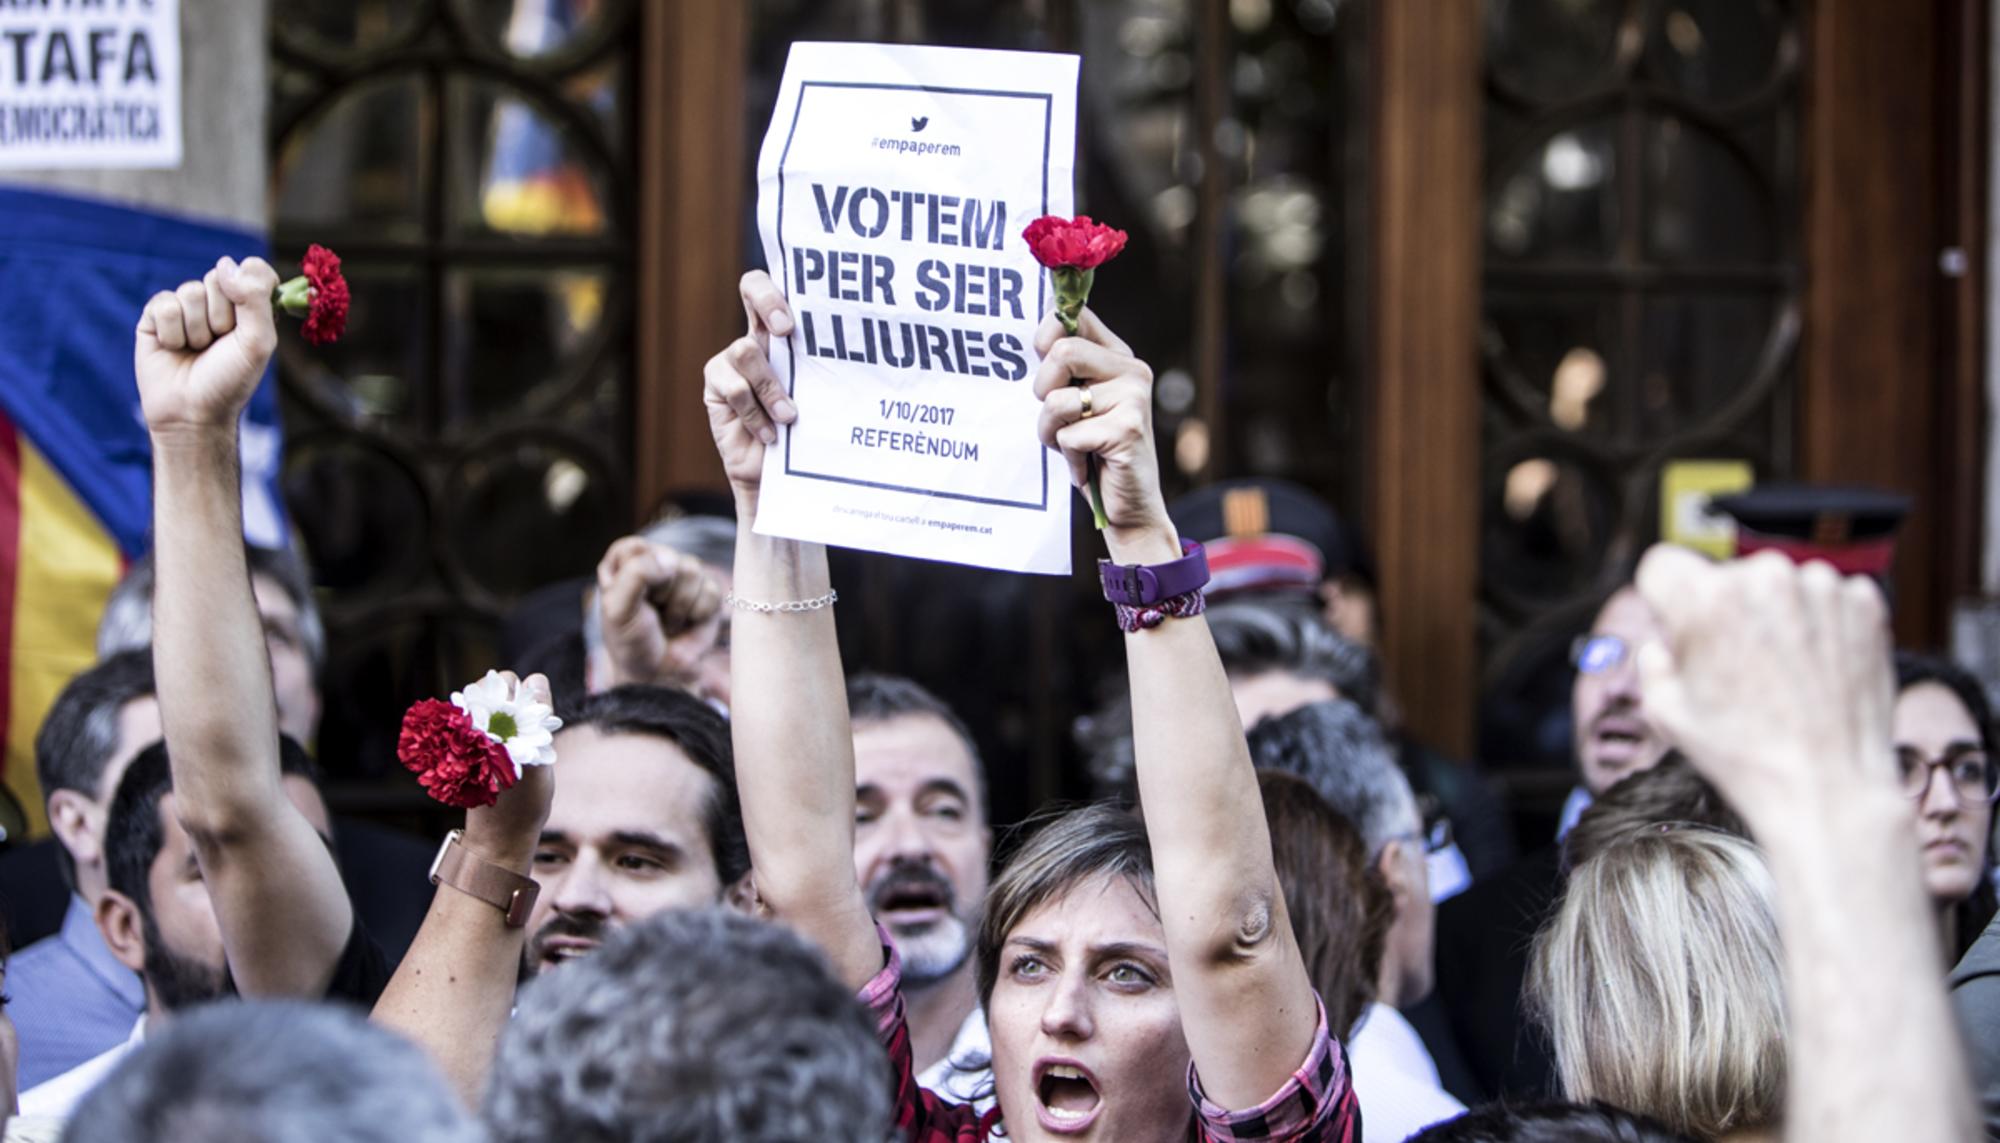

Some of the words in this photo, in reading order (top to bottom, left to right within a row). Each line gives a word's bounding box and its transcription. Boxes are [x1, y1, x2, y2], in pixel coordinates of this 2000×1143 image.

[0, 28, 158, 86] TAFA
[871, 137, 961, 157] #empaperem
[811, 183, 1007, 251] VOTEM
[792, 247, 897, 305] PER
[914, 259, 1025, 320] SER
[801, 311, 1028, 382] LLIURES
[879, 399, 955, 426] 1/10/2017
[850, 426, 979, 462] REFERÈNDUM
[927, 519, 993, 535] empaperem.cat
